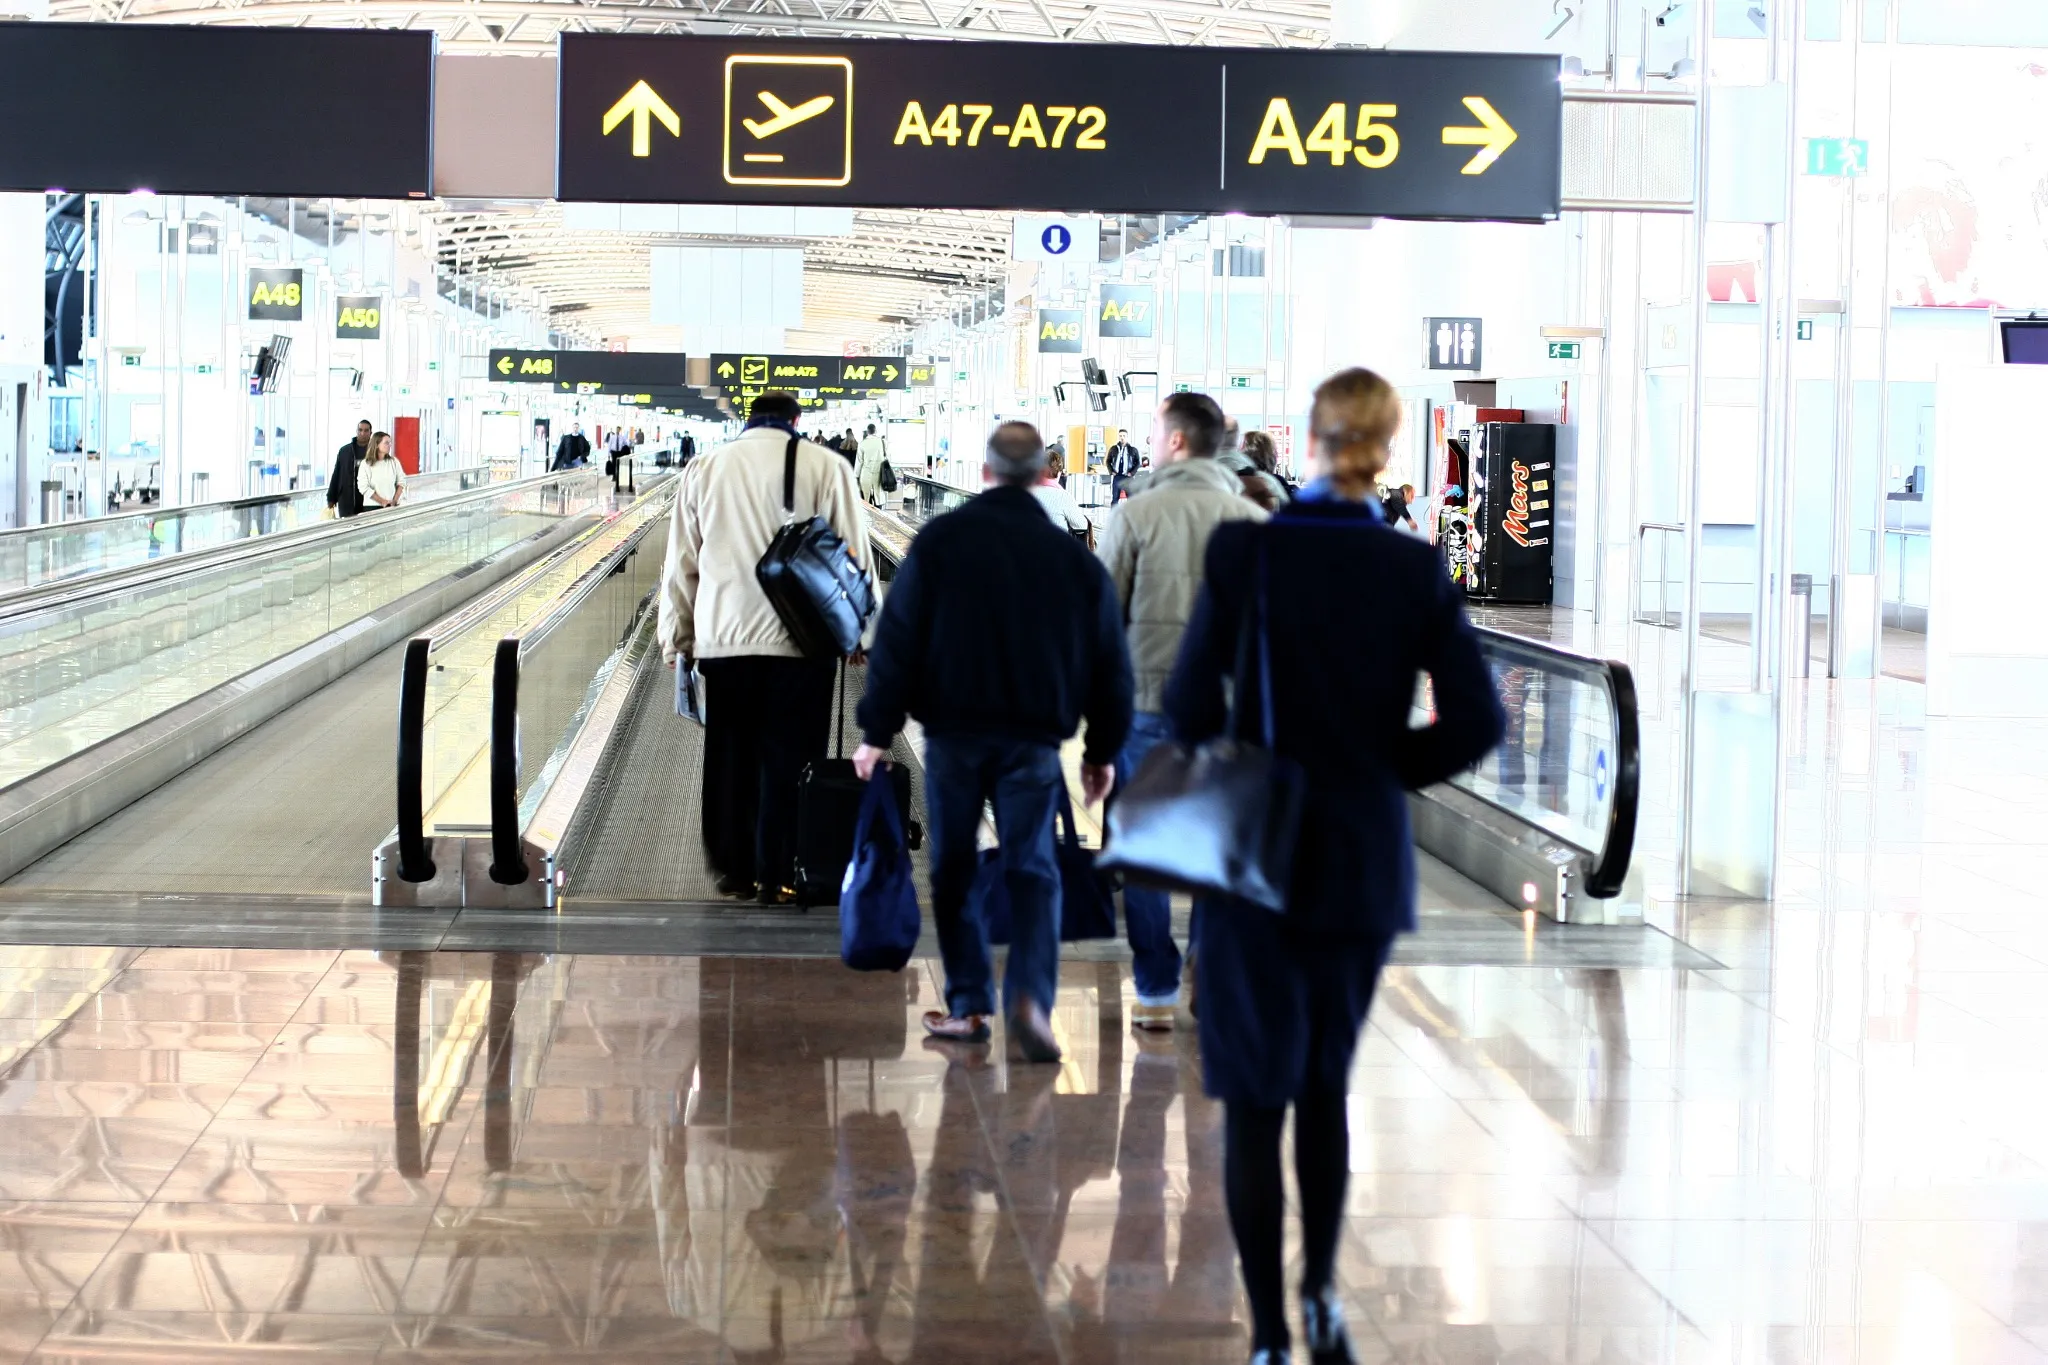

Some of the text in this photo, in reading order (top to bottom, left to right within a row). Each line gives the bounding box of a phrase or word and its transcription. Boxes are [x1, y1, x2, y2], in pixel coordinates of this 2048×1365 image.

[894, 101, 1108, 151] A47-A72
[1247, 97, 1401, 169] A45
[251, 282, 301, 307] A48
[338, 307, 379, 328] A50
[1101, 299, 1150, 321] A47
[1040, 321, 1080, 341] A49
[843, 364, 877, 380] A47
[1502, 459, 1530, 548] Mars
